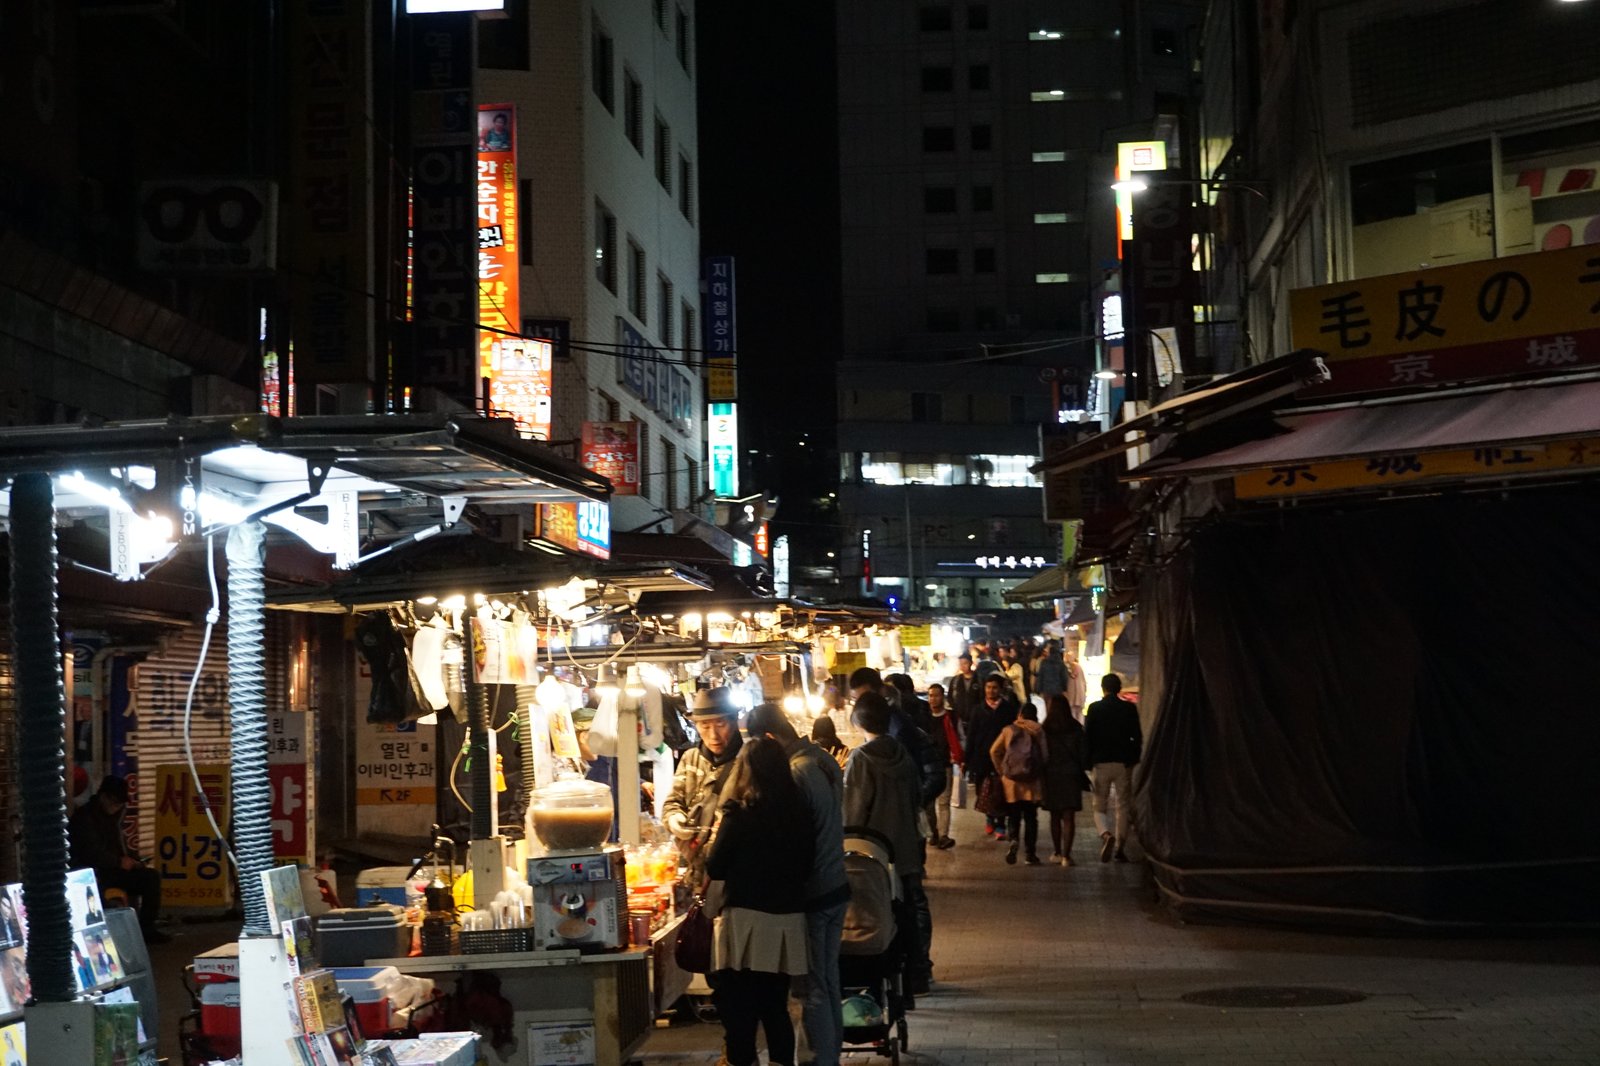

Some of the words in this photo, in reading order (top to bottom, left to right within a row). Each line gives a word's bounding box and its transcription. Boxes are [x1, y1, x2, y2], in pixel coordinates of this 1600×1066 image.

[417, 149, 472, 387] 이비인후과
[358, 762, 434, 780] 이비인후과
[381, 742, 410, 760] 열린
[158, 771, 226, 827] 서독
[159, 832, 223, 881] 안경
